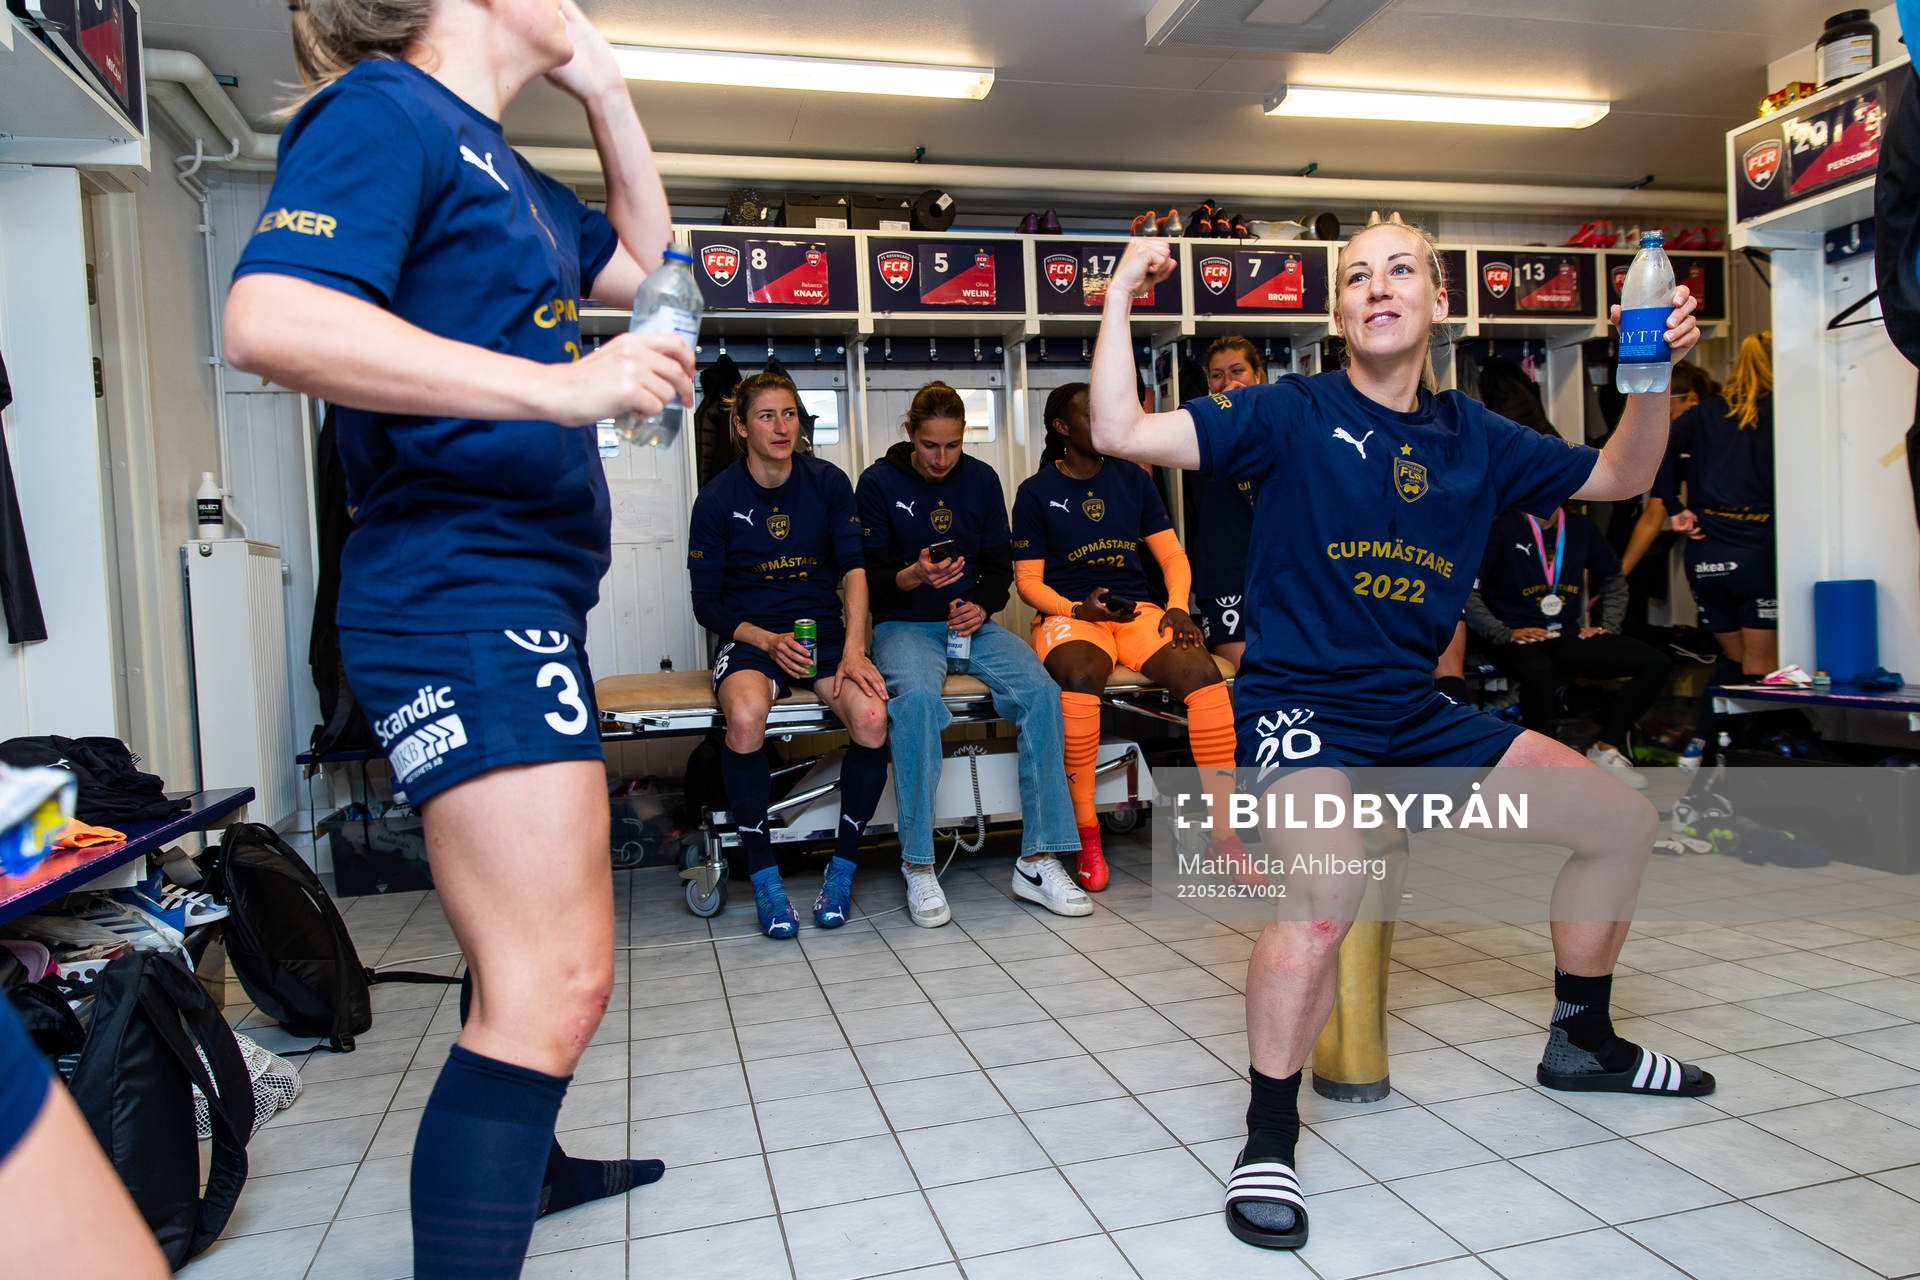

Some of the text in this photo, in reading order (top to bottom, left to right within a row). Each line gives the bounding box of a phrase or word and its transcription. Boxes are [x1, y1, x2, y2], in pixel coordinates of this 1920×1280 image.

[1748, 151, 1777, 172] FCR
[707, 255, 735, 267] FCR
[751, 248, 768, 270] 8
[883, 261, 909, 272] FCR
[934, 252, 949, 273] 5
[1088, 255, 1116, 275] 17
[1248, 258, 1262, 278] 7
[1049, 264, 1073, 274] FCR
[1204, 267, 1227, 277] FCR
[1487, 271, 1508, 281] FCR
[1522, 263, 1546, 281] 13
[962, 289, 989, 297] WELIN
[1267, 293, 1298, 301] BROWN
[1619, 329, 1664, 344] HYTT
[199, 503, 220, 511] SELECT
[1086, 504, 1102, 513] FCR
[770, 520, 786, 530] FCR
[934, 515, 950, 523] FCR
[1067, 538, 1137, 562] CUPMÄSTARE
[1327, 538, 1454, 579] CUPMÄSTARE
[1694, 561, 1725, 574] akea
[1353, 571, 1426, 604] 2022
[1221, 608, 1240, 636] 9
[1045, 623, 1072, 647] 12
[536, 661, 588, 736] 3
[374, 684, 456, 748] Scandic
[1255, 728, 1322, 784] 20
